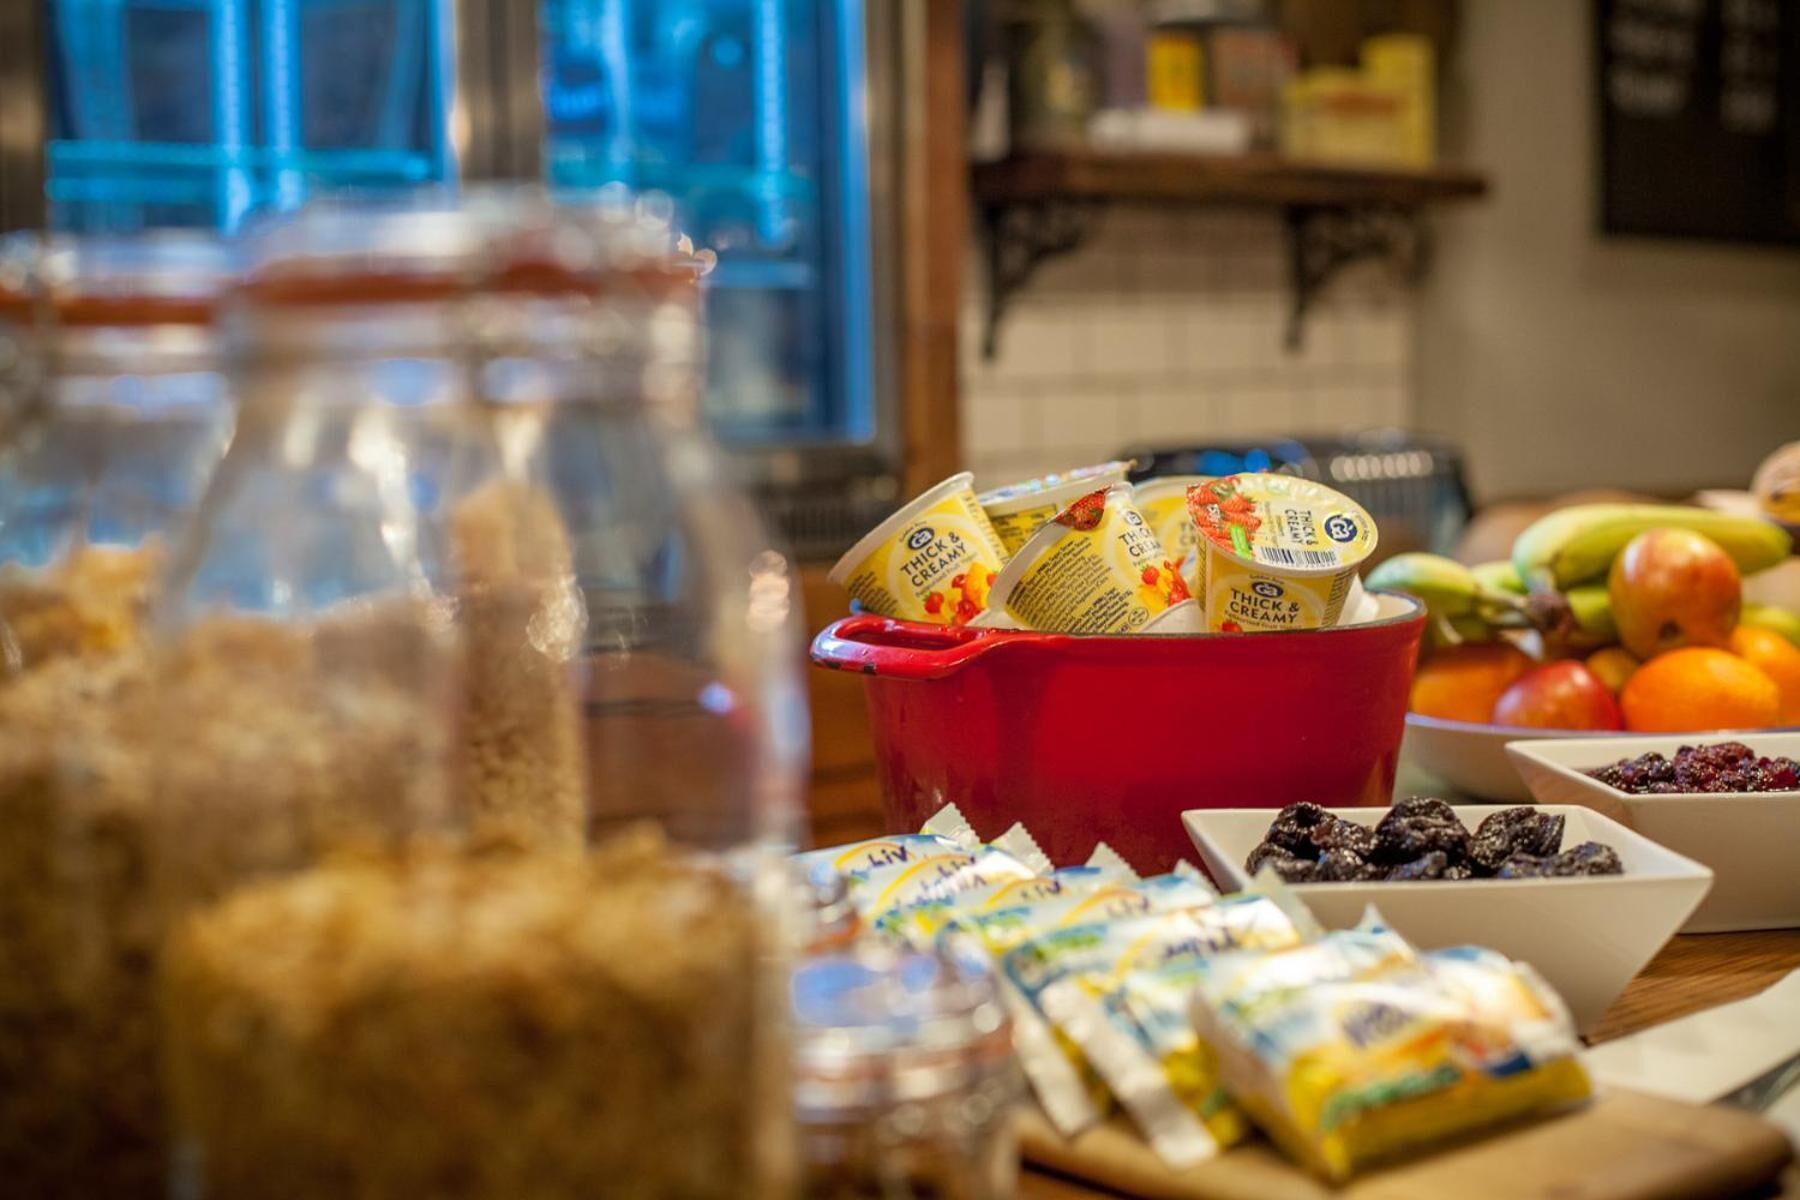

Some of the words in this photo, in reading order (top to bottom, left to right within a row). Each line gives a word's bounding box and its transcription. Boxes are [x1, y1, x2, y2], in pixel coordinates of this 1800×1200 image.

[1284, 509, 1303, 545] CREAMY
[1299, 510, 1317, 539] THICK
[900, 539, 948, 576] THICK
[948, 531, 961, 543] &
[911, 542, 966, 587] CREAMY
[1230, 601, 1297, 623] CREAMY
[1231, 588, 1283, 612] THICK
[1288, 602, 1300, 612] &
